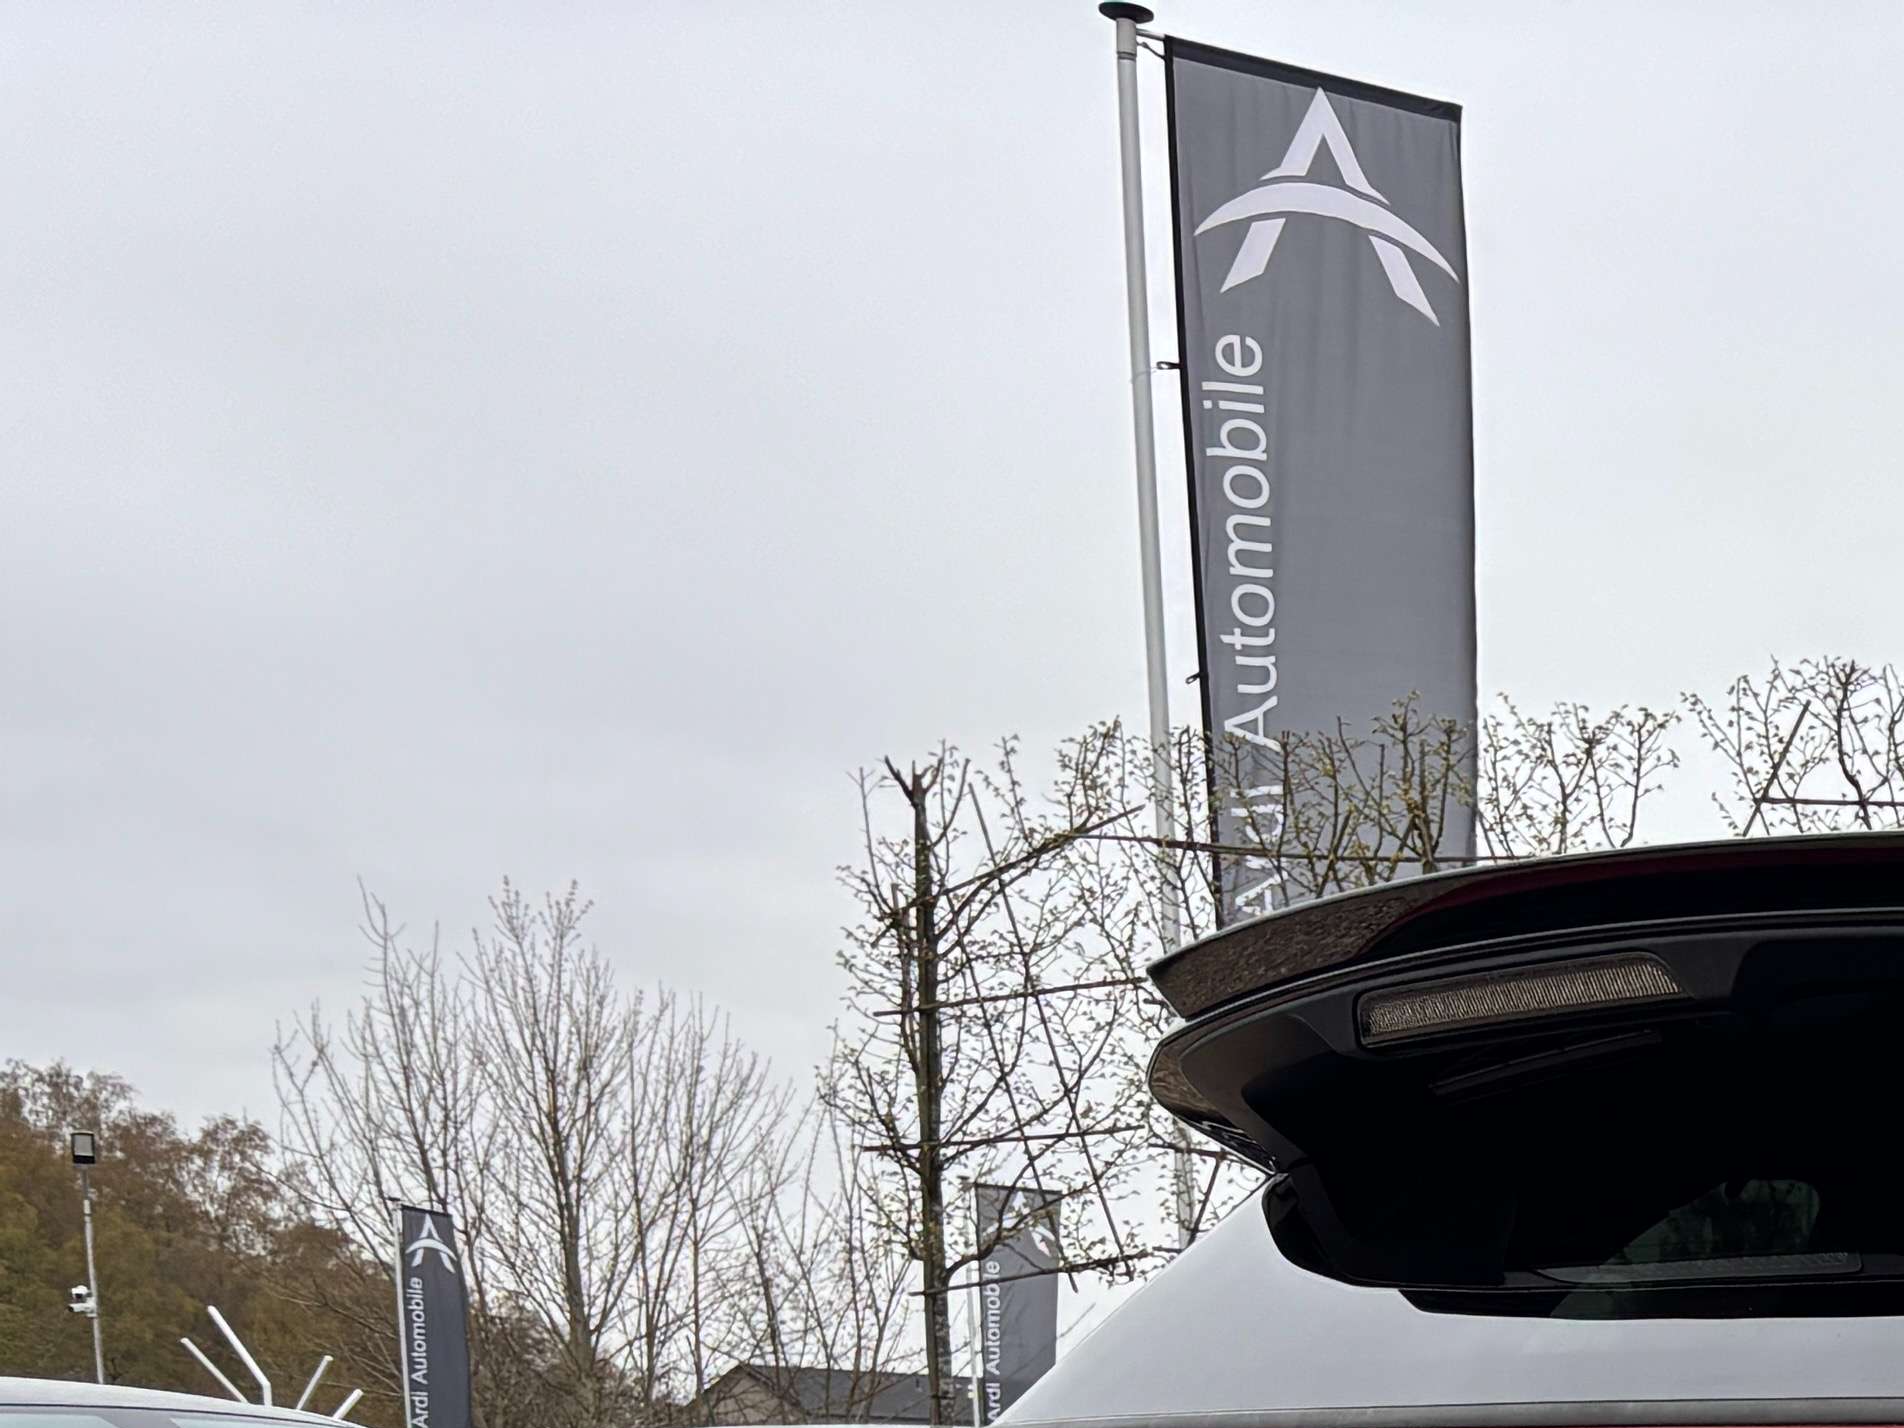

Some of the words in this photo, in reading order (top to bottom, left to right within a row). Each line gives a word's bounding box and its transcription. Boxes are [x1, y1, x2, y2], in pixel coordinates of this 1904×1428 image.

[1203, 333, 1282, 752] Automobile
[406, 1276, 429, 1385] Automobile
[983, 1260, 1001, 1375] Automoble
